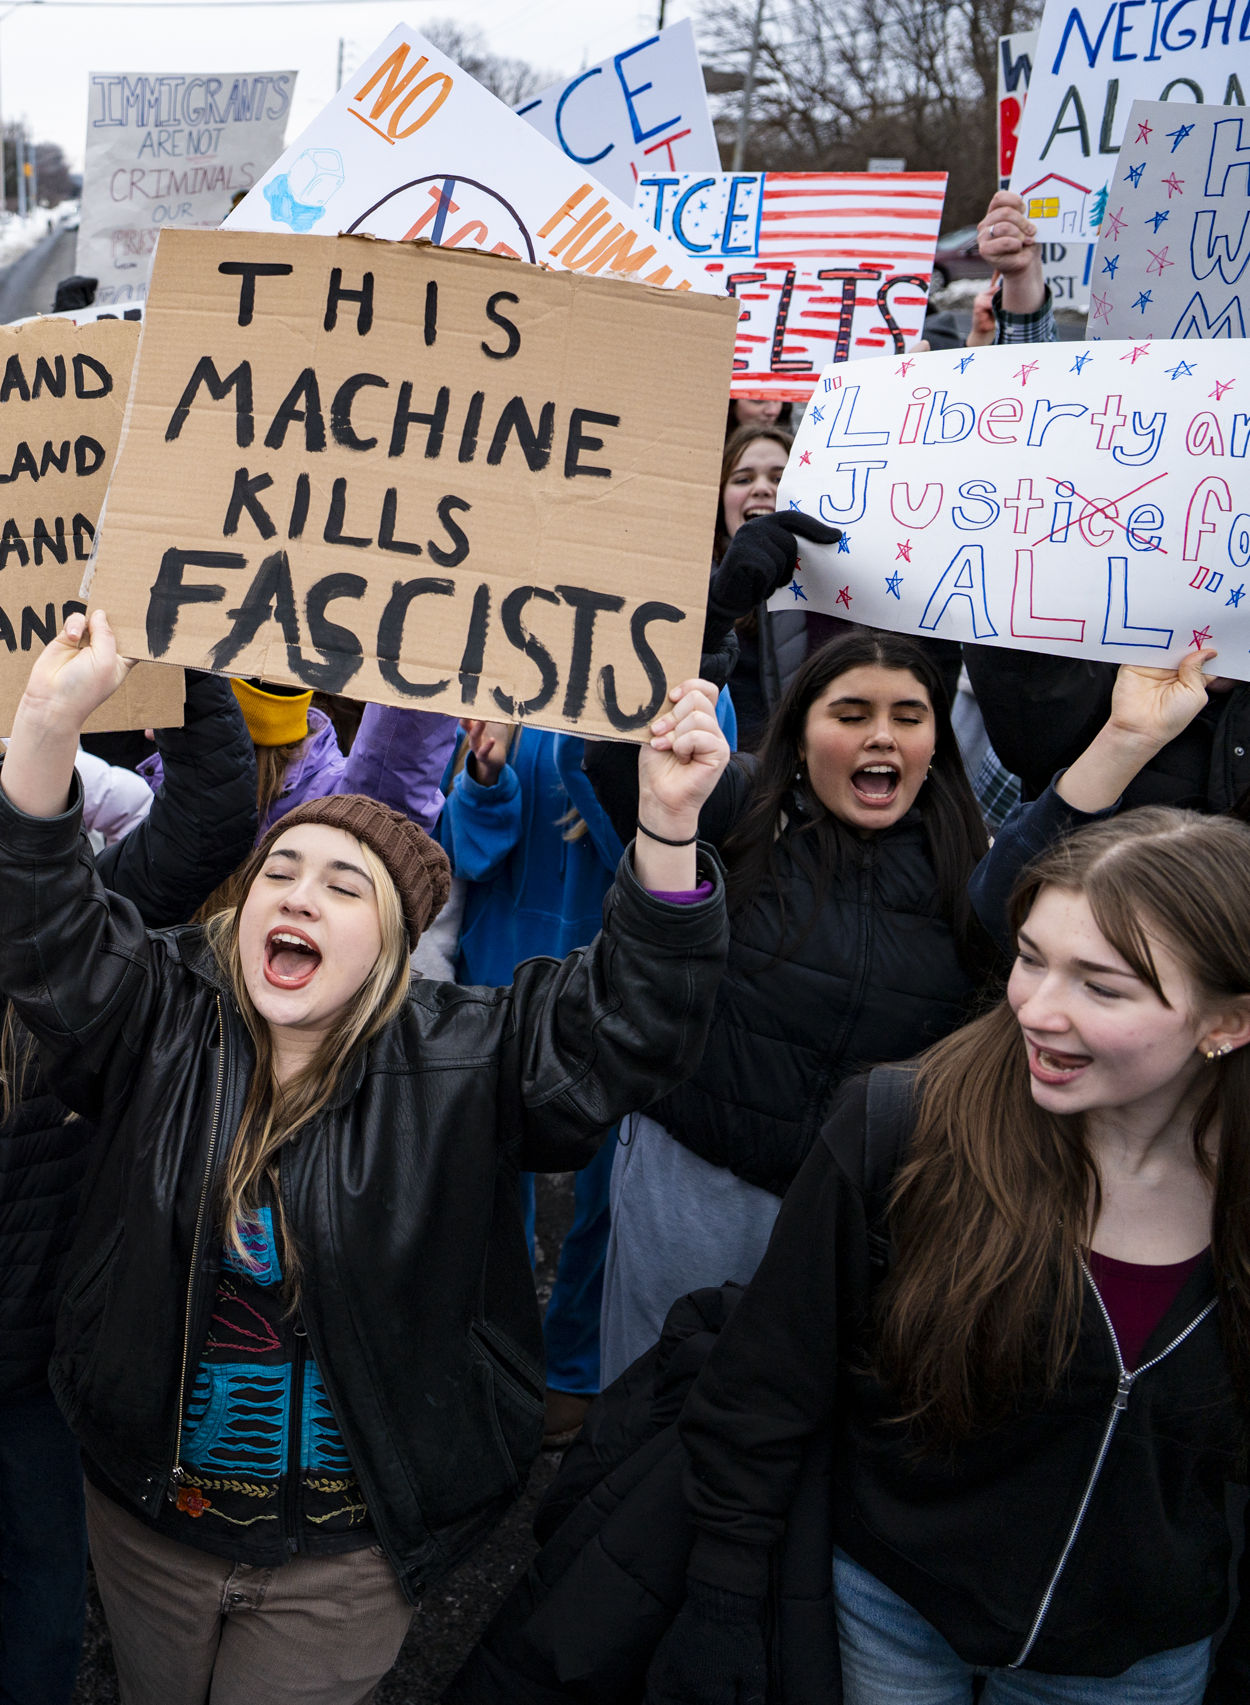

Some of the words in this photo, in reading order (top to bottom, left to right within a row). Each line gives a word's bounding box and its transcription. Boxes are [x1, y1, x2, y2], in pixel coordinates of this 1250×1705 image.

[92, 75, 290, 128] IMMIGRANTS
[354, 41, 453, 139] NO
[516, 35, 682, 165] CE
[110, 162, 256, 202] CRIMINALS
[137, 129, 185, 159] ARE
[186, 128, 225, 157] NOT
[151, 202, 194, 223] OUR
[218, 260, 522, 360] THIS
[164, 355, 621, 479] MACHINE
[223, 467, 472, 567] KILLS
[819, 460, 1165, 551] Justice
[146, 546, 687, 732] FASCISTS
